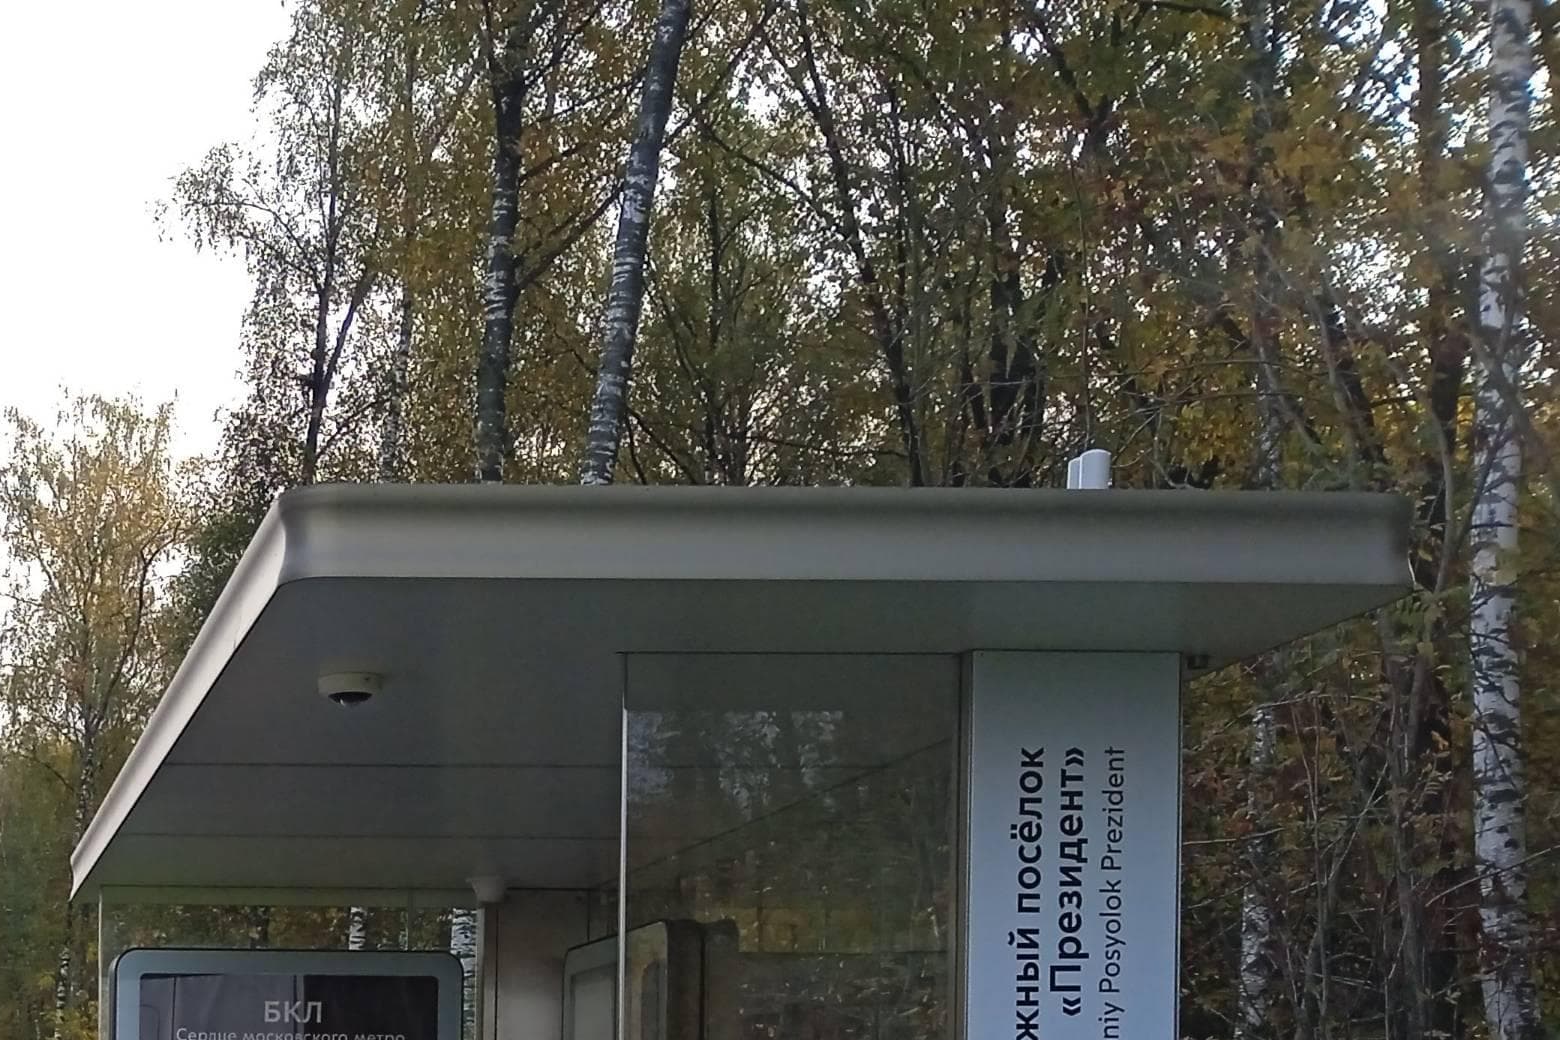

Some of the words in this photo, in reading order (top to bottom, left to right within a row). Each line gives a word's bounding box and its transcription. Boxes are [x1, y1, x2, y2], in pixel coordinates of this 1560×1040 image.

[1010, 747, 1045, 914] посёлок
[1101, 746, 1126, 871] Prezident
[1050, 746, 1089, 1018] «Президент»
[1099, 879, 1127, 993] Posyolok
[264, 1001, 322, 1023] БКЛ
